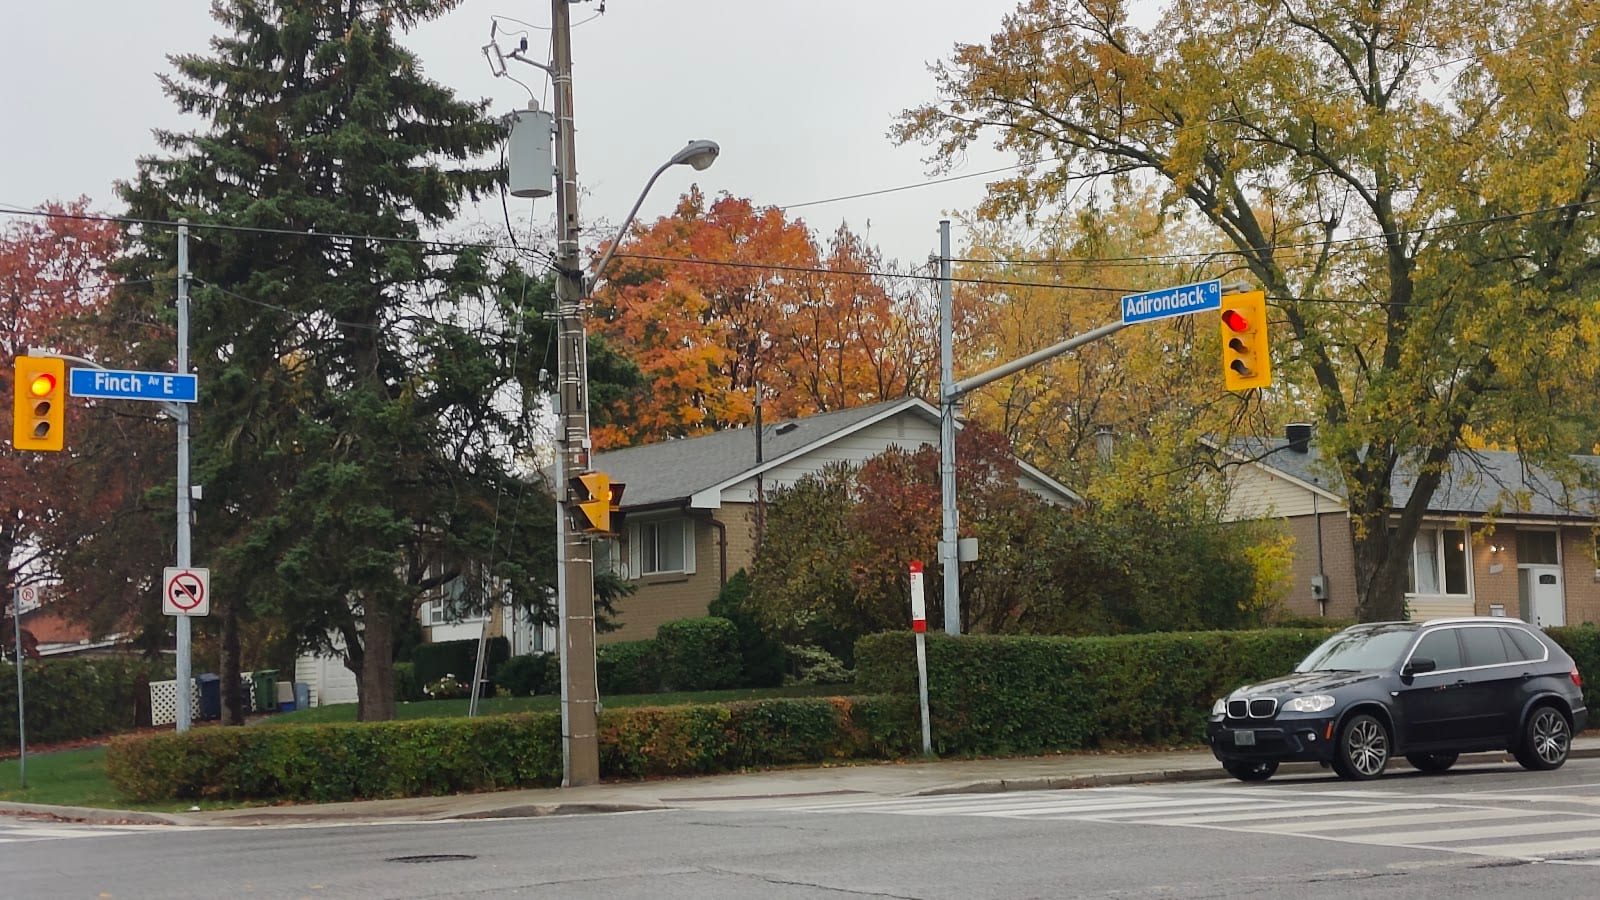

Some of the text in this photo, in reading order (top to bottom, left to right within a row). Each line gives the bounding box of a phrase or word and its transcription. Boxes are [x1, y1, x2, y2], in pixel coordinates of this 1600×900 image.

[1126, 286, 1205, 317] Adirondack
[95, 372, 174, 395] Finch Av E
